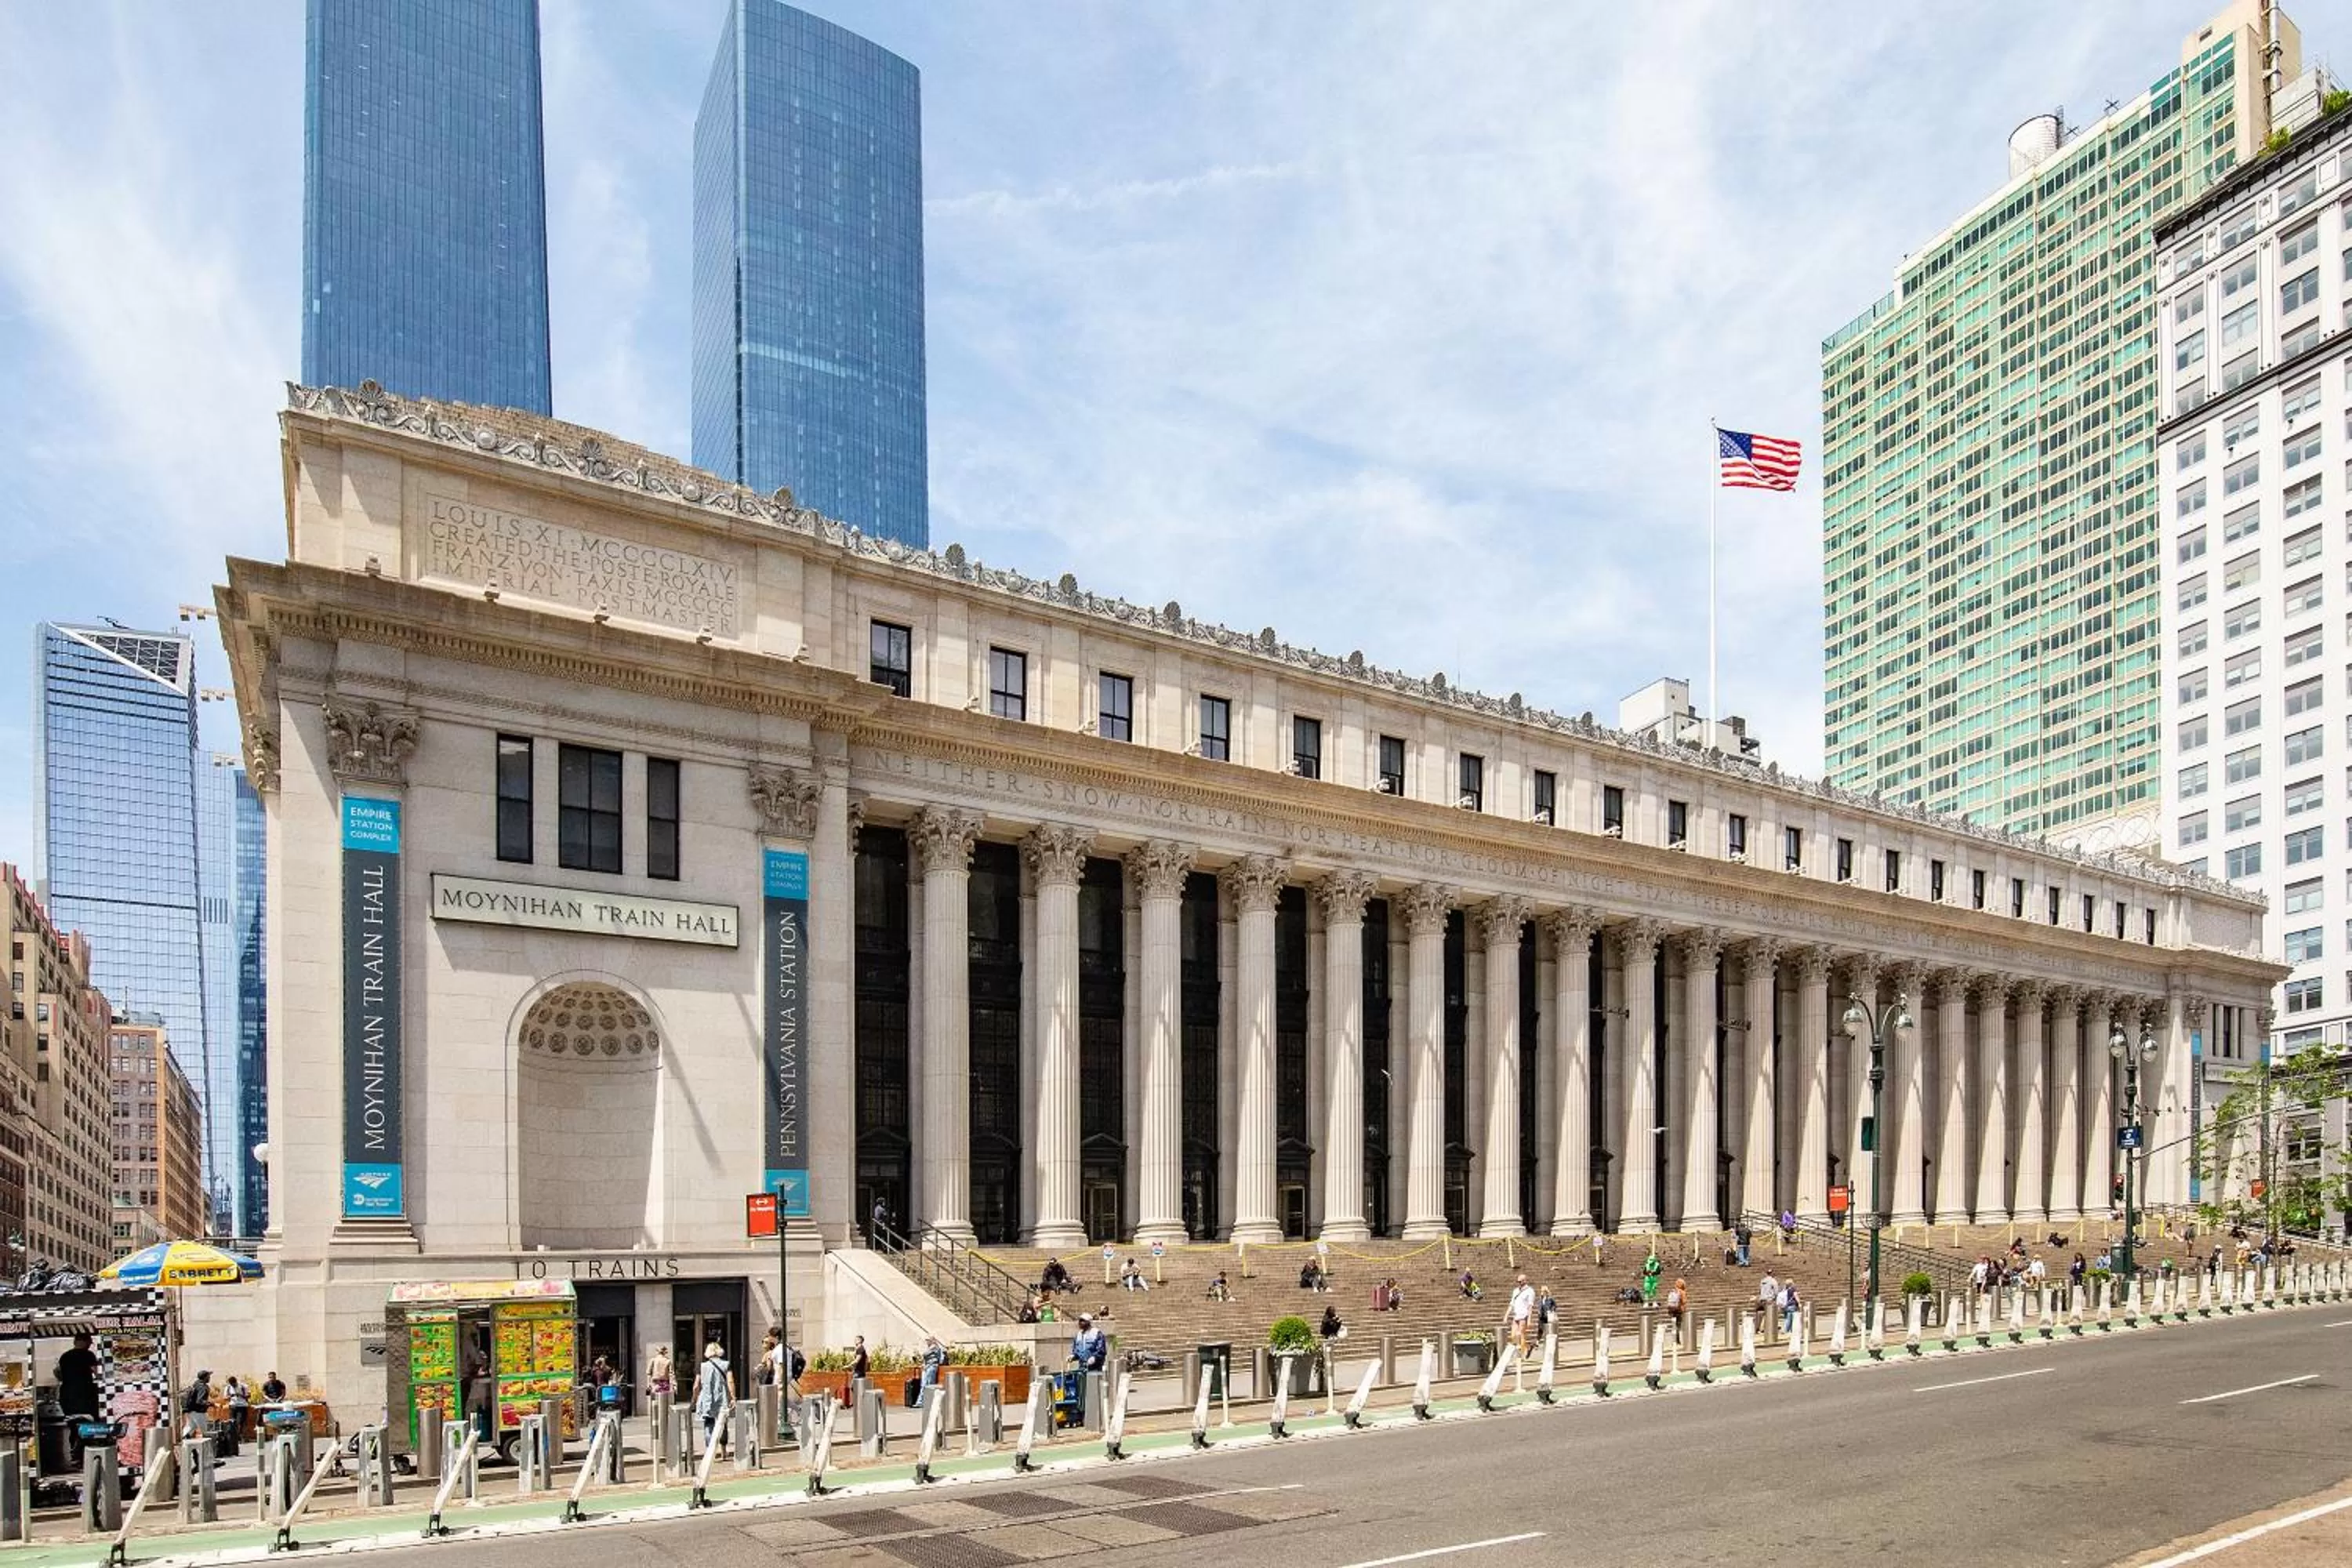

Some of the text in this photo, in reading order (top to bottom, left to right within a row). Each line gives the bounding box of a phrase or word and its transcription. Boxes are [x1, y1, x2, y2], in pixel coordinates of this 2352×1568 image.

[434, 501, 521, 537] LOUIS
[430, 521, 735, 602] CREATED THE POSTE ROYALE
[432, 539, 510, 570] FRANZ
[517, 557, 563, 579] VON
[573, 569, 637, 597] TAXIS
[432, 557, 731, 633] IMPERIAL POSTMASTER
[350, 807, 392, 820] EMPIRE
[350, 819, 393, 831] STATION
[873, 749, 1023, 793] NEITHER
[1044, 780, 1121, 809] SNOW
[1138, 796, 1192, 822] NOR
[1207, 808, 1267, 834] RAIN
[1283, 817, 1330, 844] NOR
[1341, 832, 1397, 857] HEAT
[363, 865, 383, 924] HALL
[441, 889, 732, 935] MOYNIHAN TRAIN HALL
[363, 933, 383, 1007] TRAIN
[780, 912, 797, 1157] PENNSYLVANIA STATION
[363, 1015, 385, 1151] MOYNIHAN
[168, 1268, 234, 1279] SABRETT
[514, 1258, 680, 1280] TO TRAINS
